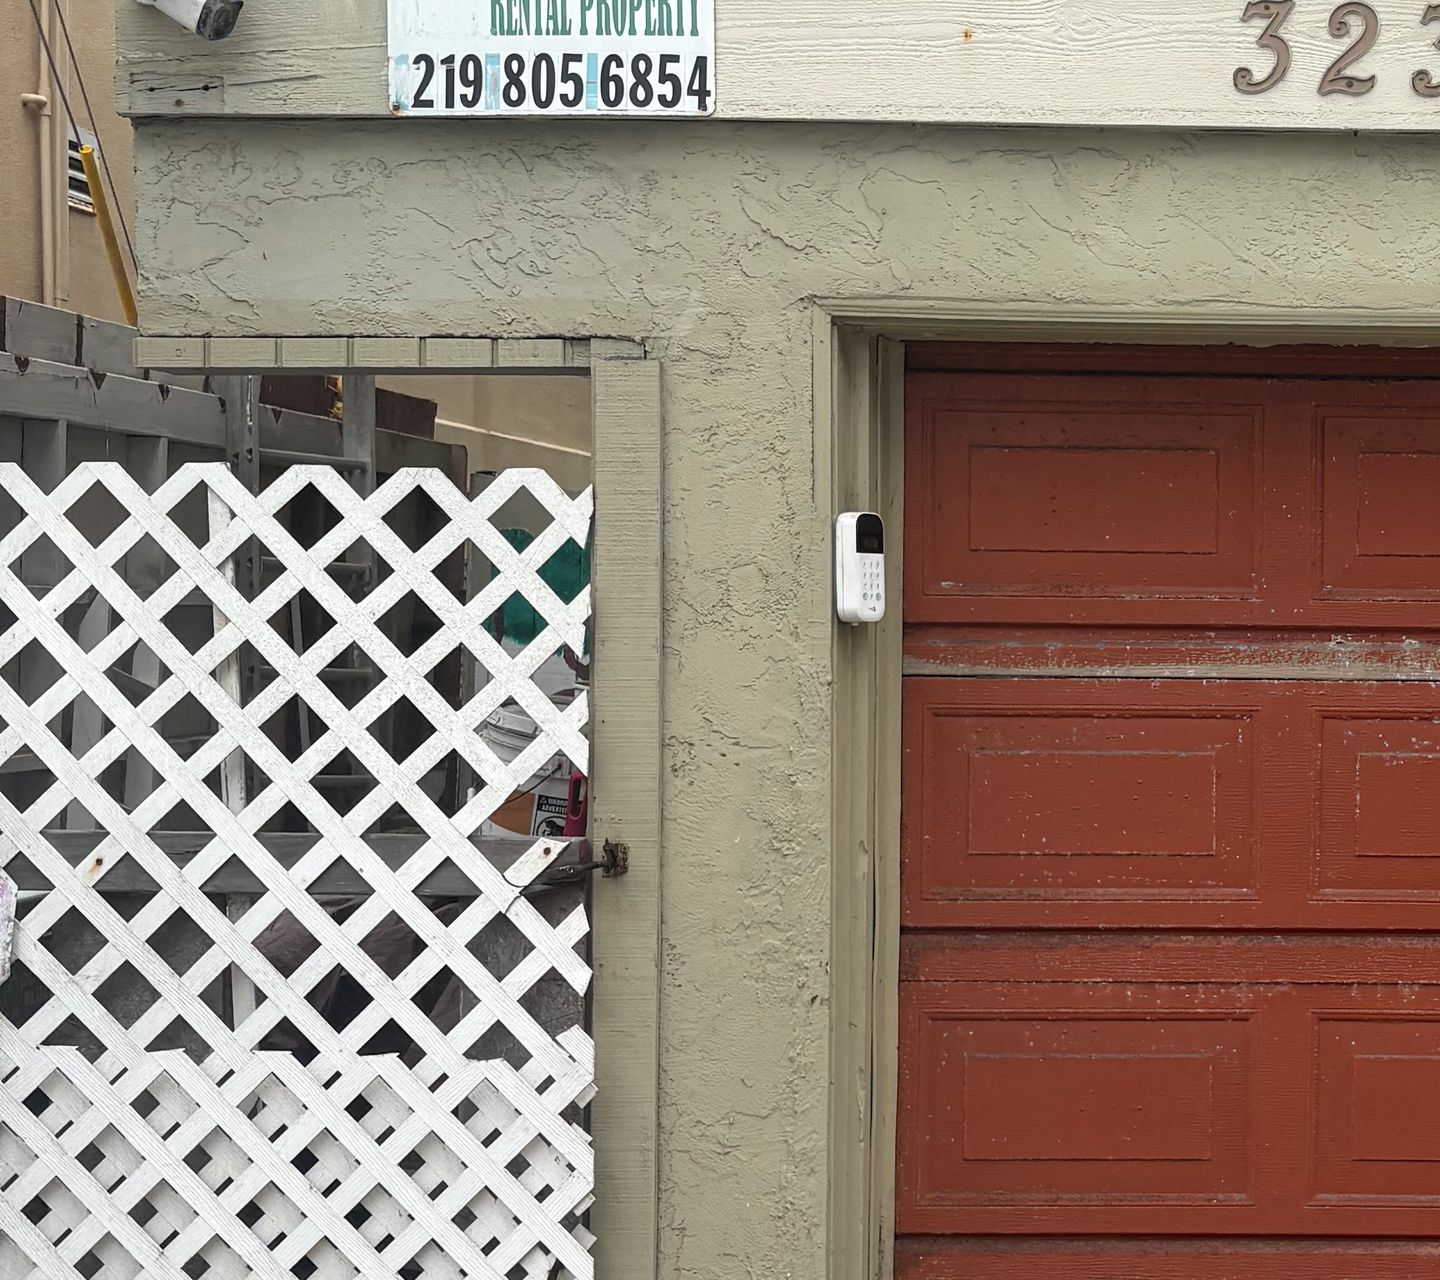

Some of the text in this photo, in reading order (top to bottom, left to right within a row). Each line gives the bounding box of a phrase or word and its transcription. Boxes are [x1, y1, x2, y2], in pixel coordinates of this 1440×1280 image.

[411, 52, 711, 112] 219 805 6854
